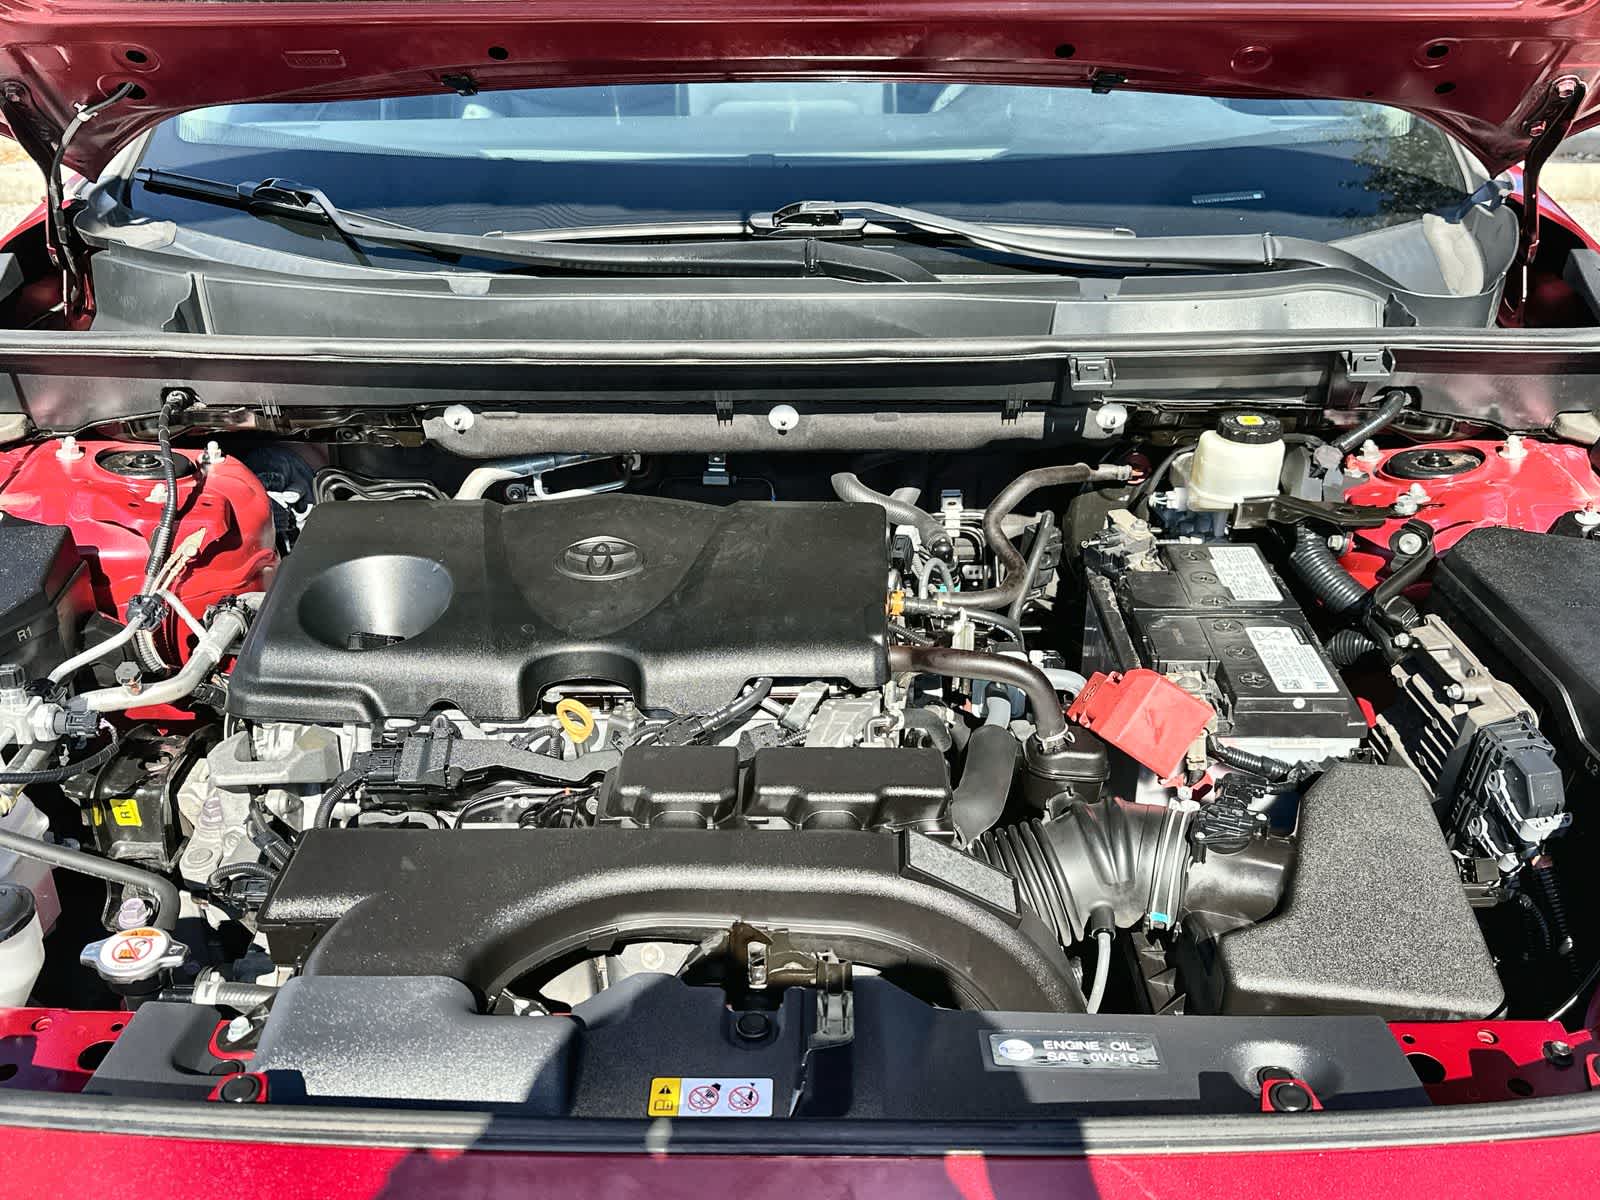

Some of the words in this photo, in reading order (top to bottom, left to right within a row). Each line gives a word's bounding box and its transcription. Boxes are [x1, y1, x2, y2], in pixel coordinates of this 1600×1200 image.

[17, 625, 33, 642] R1
[1043, 1040, 1101, 1050] ENGINE
[1110, 1042, 1137, 1051] OIL
[1047, 1052, 1079, 1062] SAE
[1090, 1053, 1140, 1062] 0W-16
